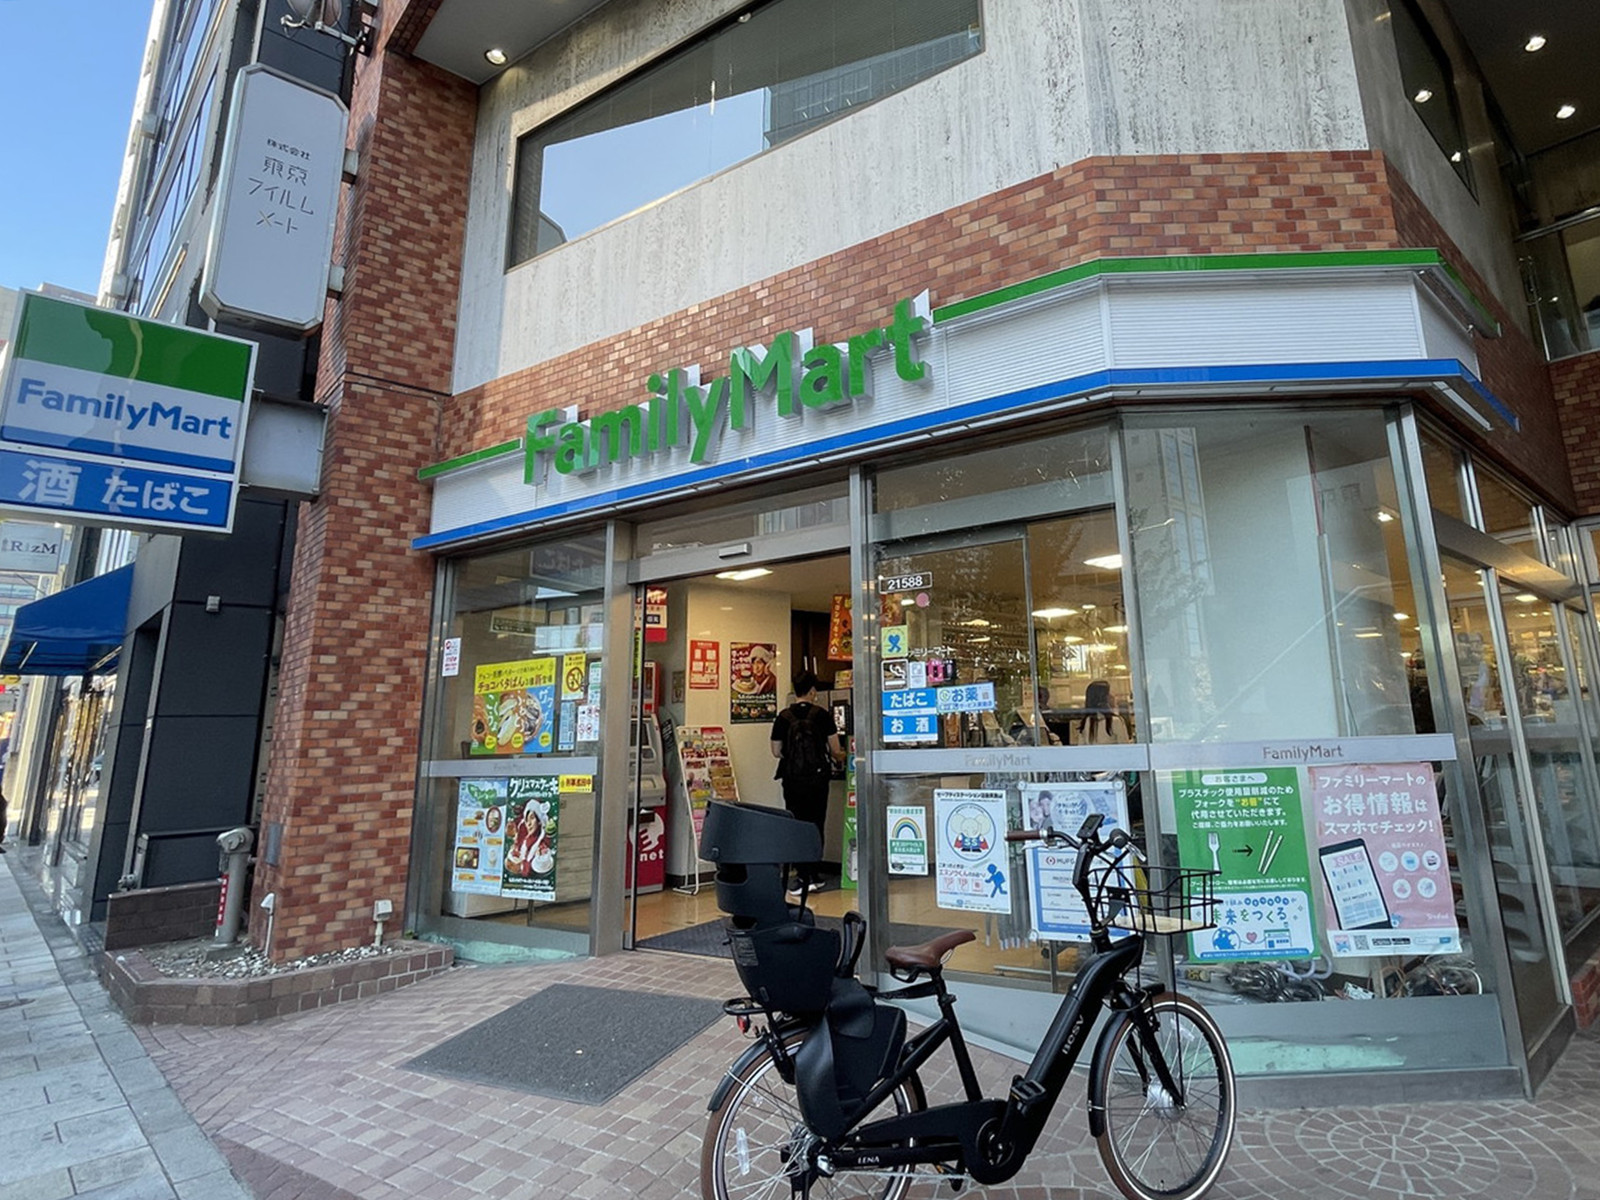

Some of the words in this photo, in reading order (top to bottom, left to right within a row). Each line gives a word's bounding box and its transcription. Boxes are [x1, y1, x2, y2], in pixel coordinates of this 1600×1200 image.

[267, 138, 310, 160] 株式会社
[263, 156, 309, 186] 東京
[523, 297, 928, 486] FamilyMart
[17, 377, 232, 439] FamilyMart
[18, 459, 82, 507] 酒
[101, 474, 211, 516] たばこ
[887, 576, 923, 590] 21588
[890, 692, 928, 708] たばこ
[964, 753, 1032, 767] FamilyMart
[1262, 745, 1344, 760] FamilyMart
[1319, 772, 1426, 788] ファミリーマートの
[1323, 791, 1428, 816] お得情報は
[639, 848, 664, 862] net
